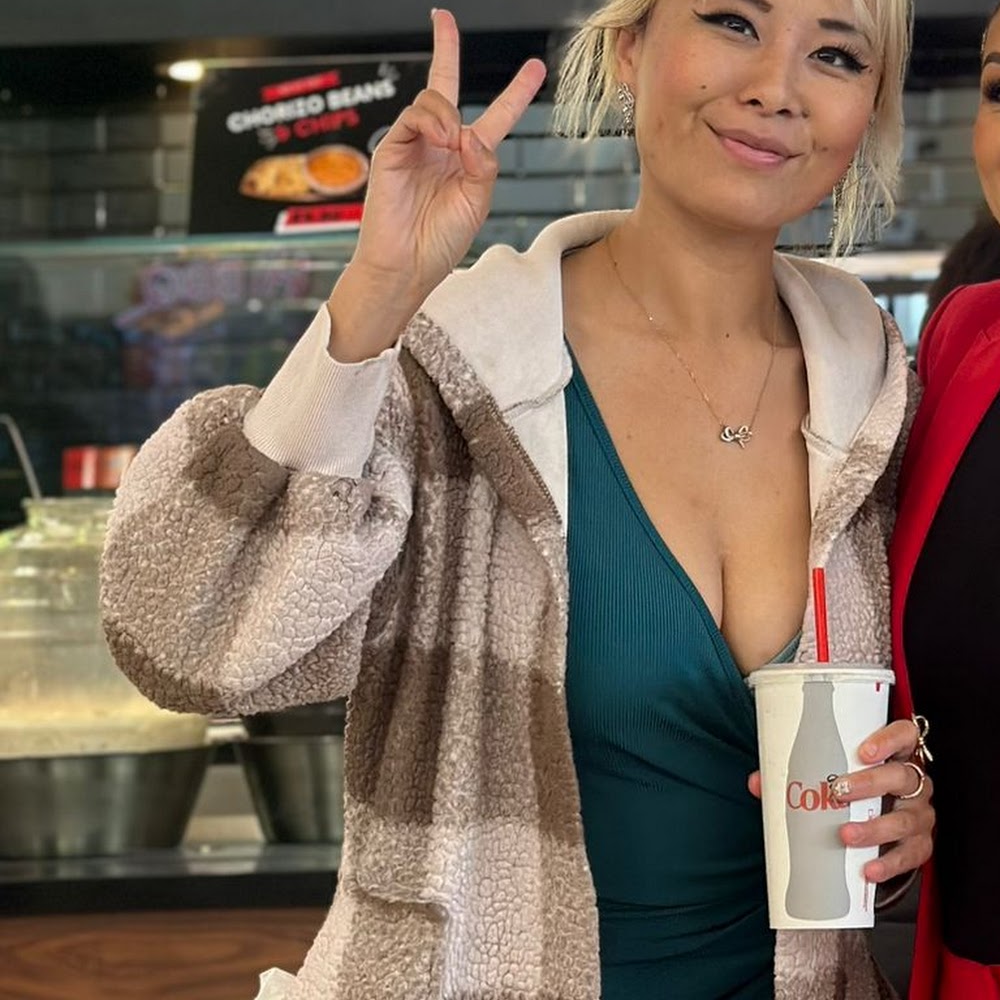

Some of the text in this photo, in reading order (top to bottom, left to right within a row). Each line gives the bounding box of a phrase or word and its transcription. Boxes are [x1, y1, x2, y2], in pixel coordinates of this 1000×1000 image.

[226, 94, 325, 133] CHORIZO
[326, 77, 396, 112] BEANS
[293, 109, 360, 138] CHIPS
